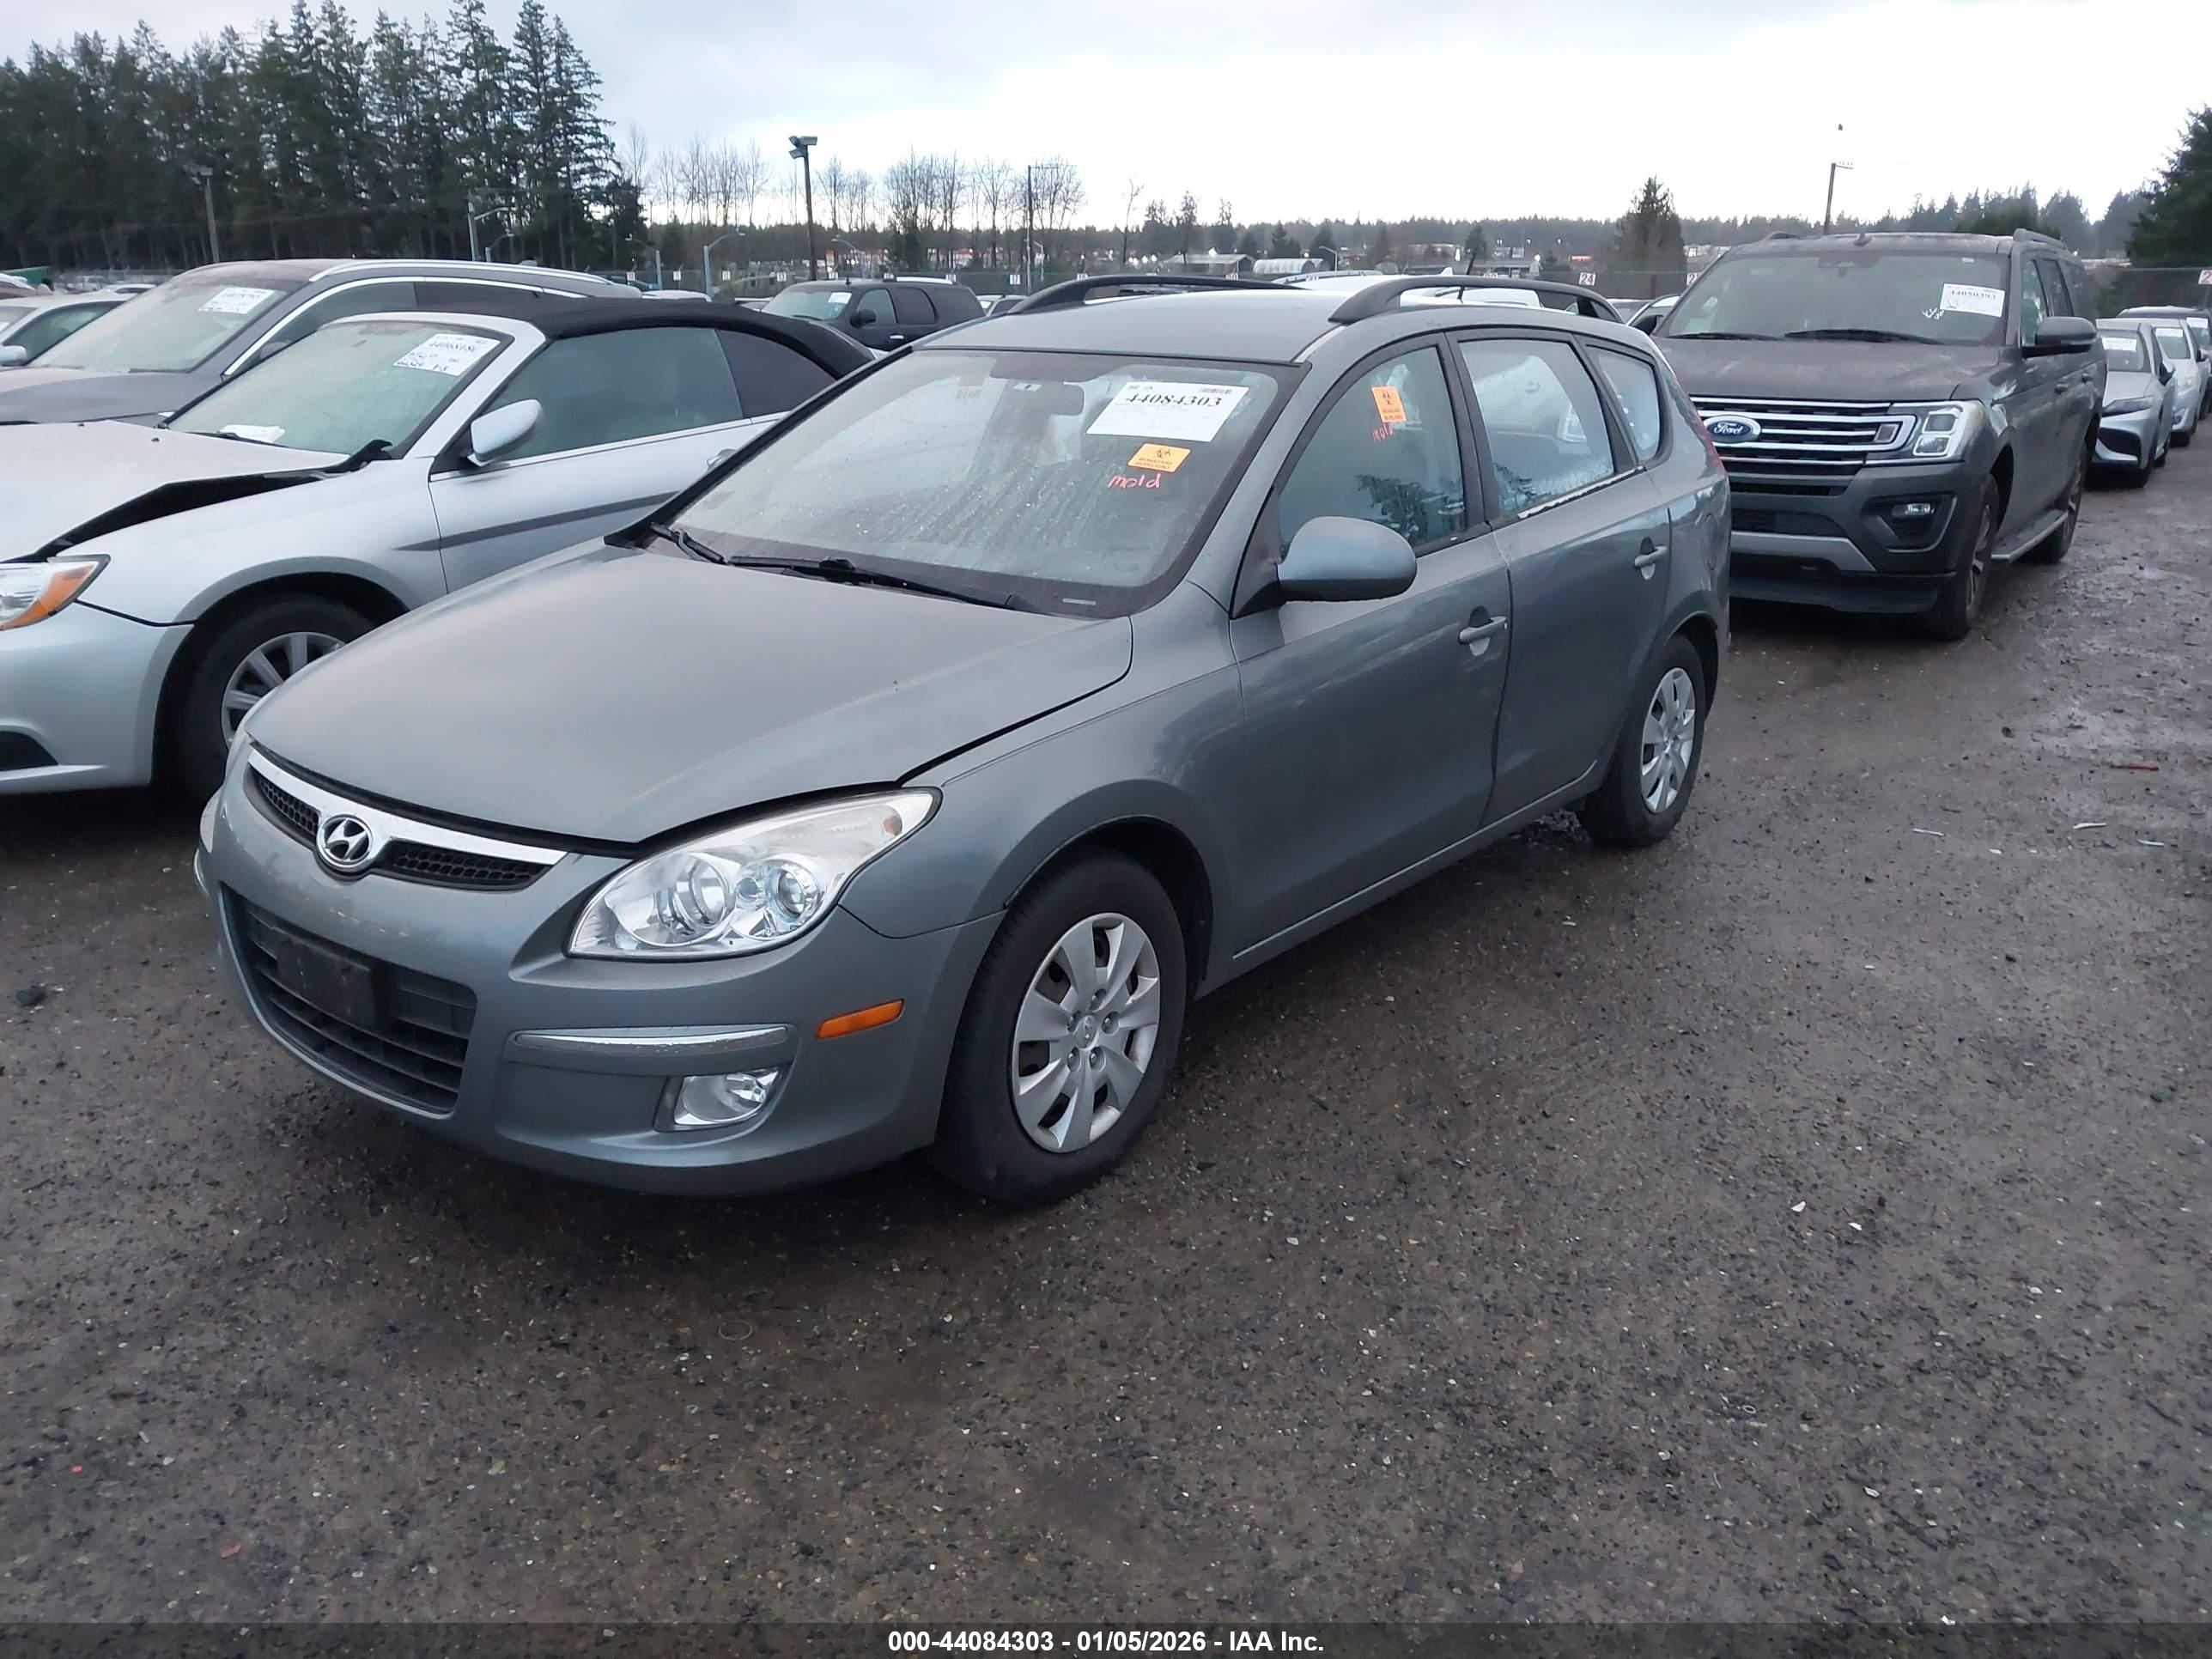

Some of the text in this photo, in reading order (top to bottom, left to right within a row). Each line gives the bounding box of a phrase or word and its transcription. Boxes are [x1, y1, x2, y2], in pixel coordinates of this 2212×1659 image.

[1581, 272, 1594, 283] 24
[1126, 393, 1222, 406] 44084303
[1713, 421, 1743, 434] Ford
[1107, 472, 1162, 489] mold
